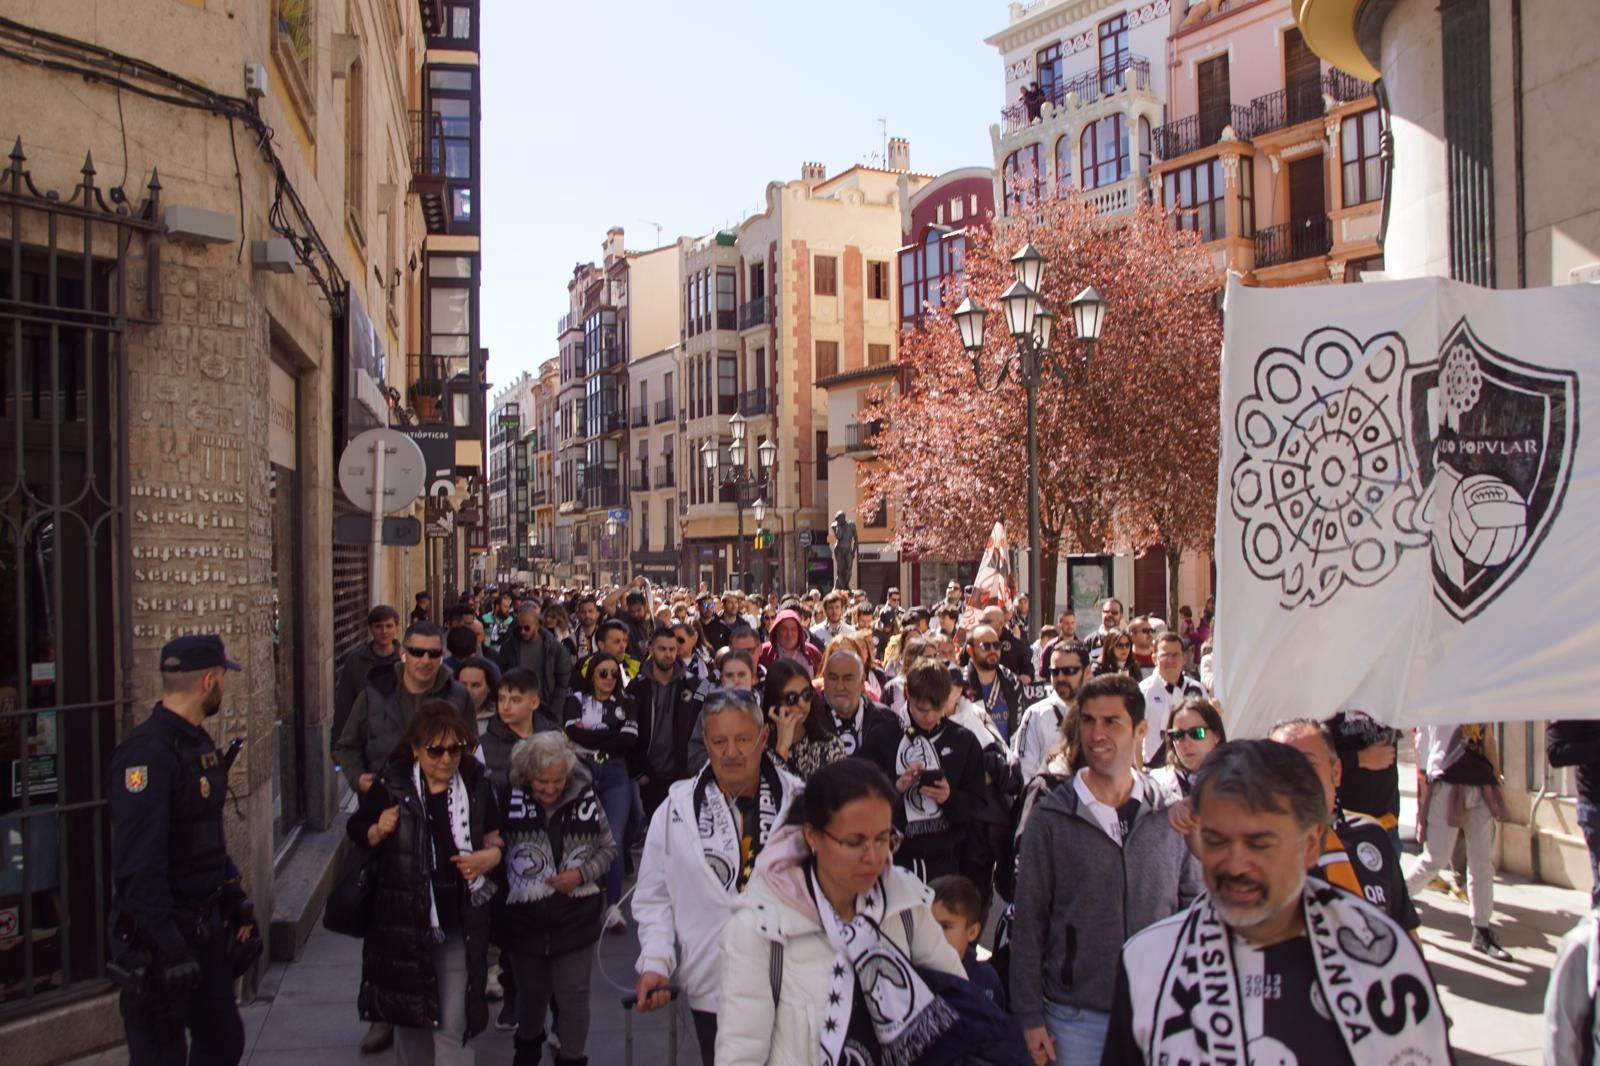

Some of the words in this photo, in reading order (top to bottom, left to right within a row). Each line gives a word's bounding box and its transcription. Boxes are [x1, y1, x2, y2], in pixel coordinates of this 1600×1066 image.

[1459, 439, 1538, 455] POPVLAR
[1245, 974, 1282, 985] 2013
[1245, 986, 1282, 999] 2023
